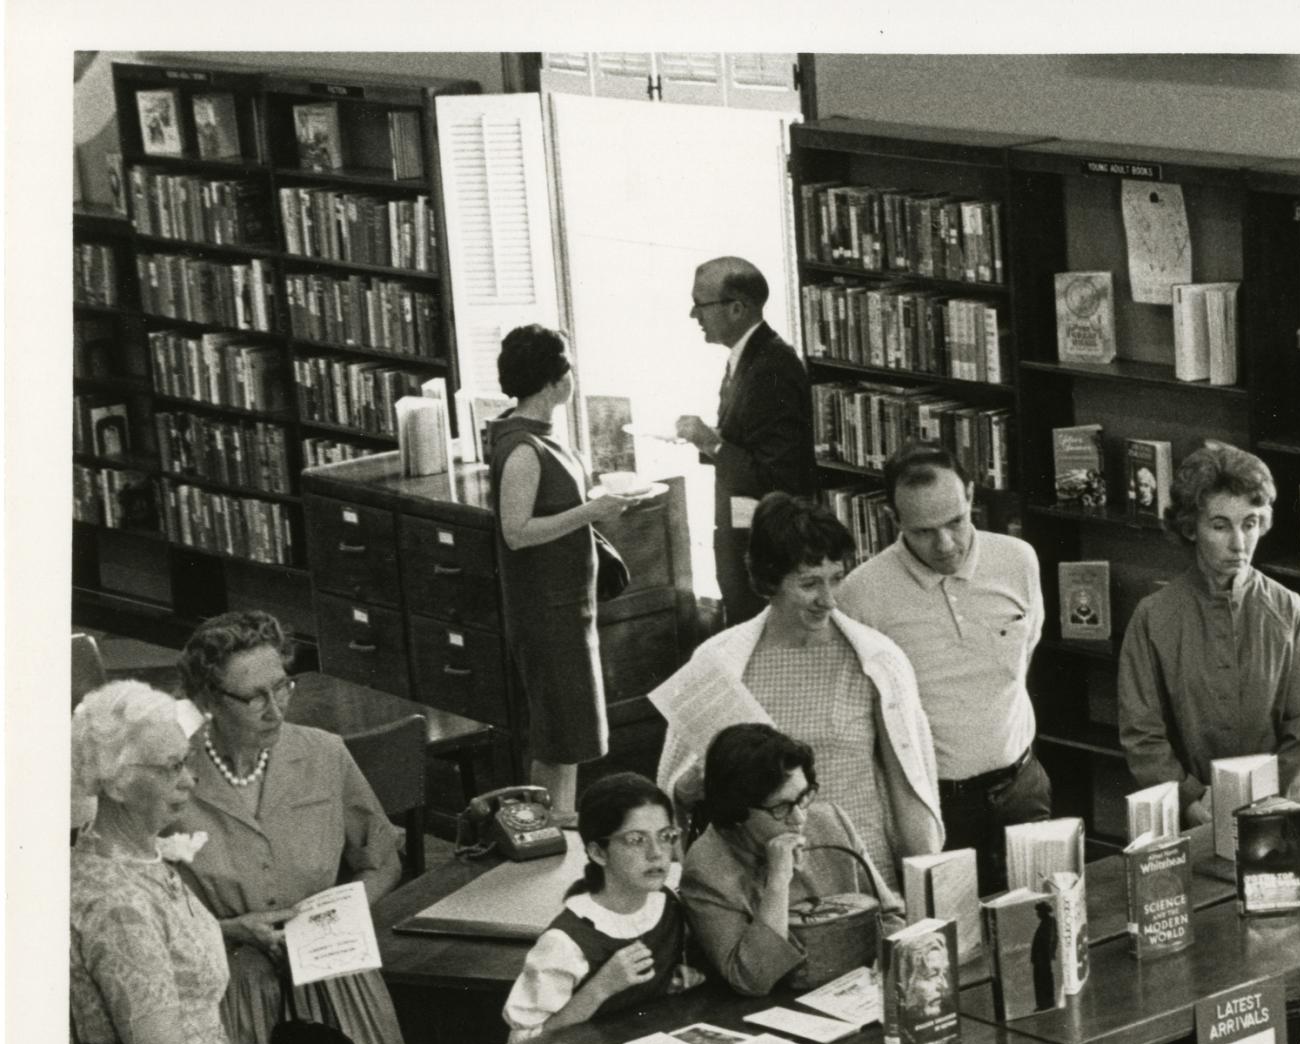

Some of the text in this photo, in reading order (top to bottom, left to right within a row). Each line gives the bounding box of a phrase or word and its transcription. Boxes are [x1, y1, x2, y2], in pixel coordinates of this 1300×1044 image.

[1087, 162, 1154, 177] YOUNG ADULT BOOKS
[1140, 852, 1187, 875] Whitehead
[1143, 893, 1187, 915] SCIENCE
[1143, 913, 1189, 936] MODERN
[1149, 926, 1186, 945] WORLD
[1216, 993, 1262, 1020] LATEST
[1209, 1007, 1270, 1041] ARRIVALS
